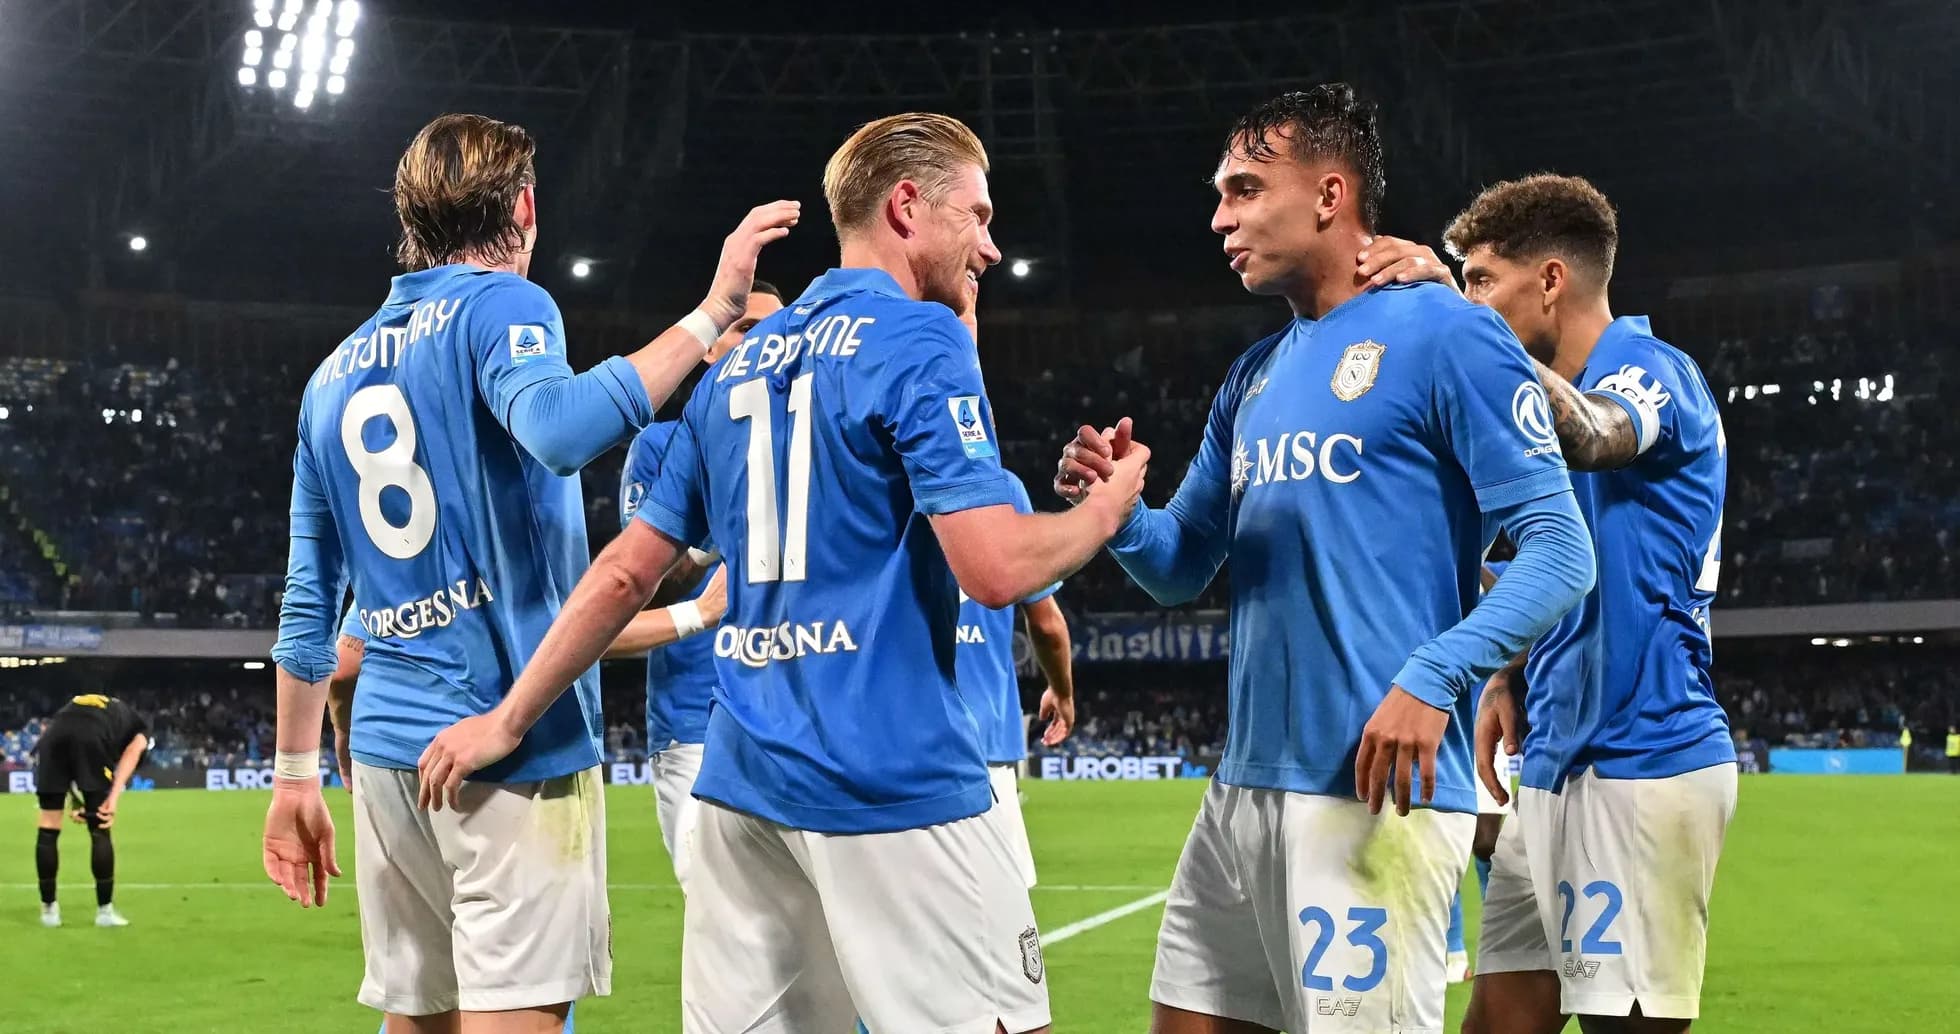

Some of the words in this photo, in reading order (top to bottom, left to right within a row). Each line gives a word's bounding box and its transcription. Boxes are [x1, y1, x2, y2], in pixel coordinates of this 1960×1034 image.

[716, 336, 760, 383] DE
[340, 383, 437, 560] 8
[728, 371, 814, 584] 11
[1253, 430, 1363, 486] MSC
[206, 768, 330, 791] EUROT
[1041, 756, 1182, 780] EUROBET
[1558, 880, 1623, 954] 22
[1299, 906, 1387, 992] 23
[1563, 959, 1601, 979] EA7
[1316, 996, 1362, 1017] EA7
